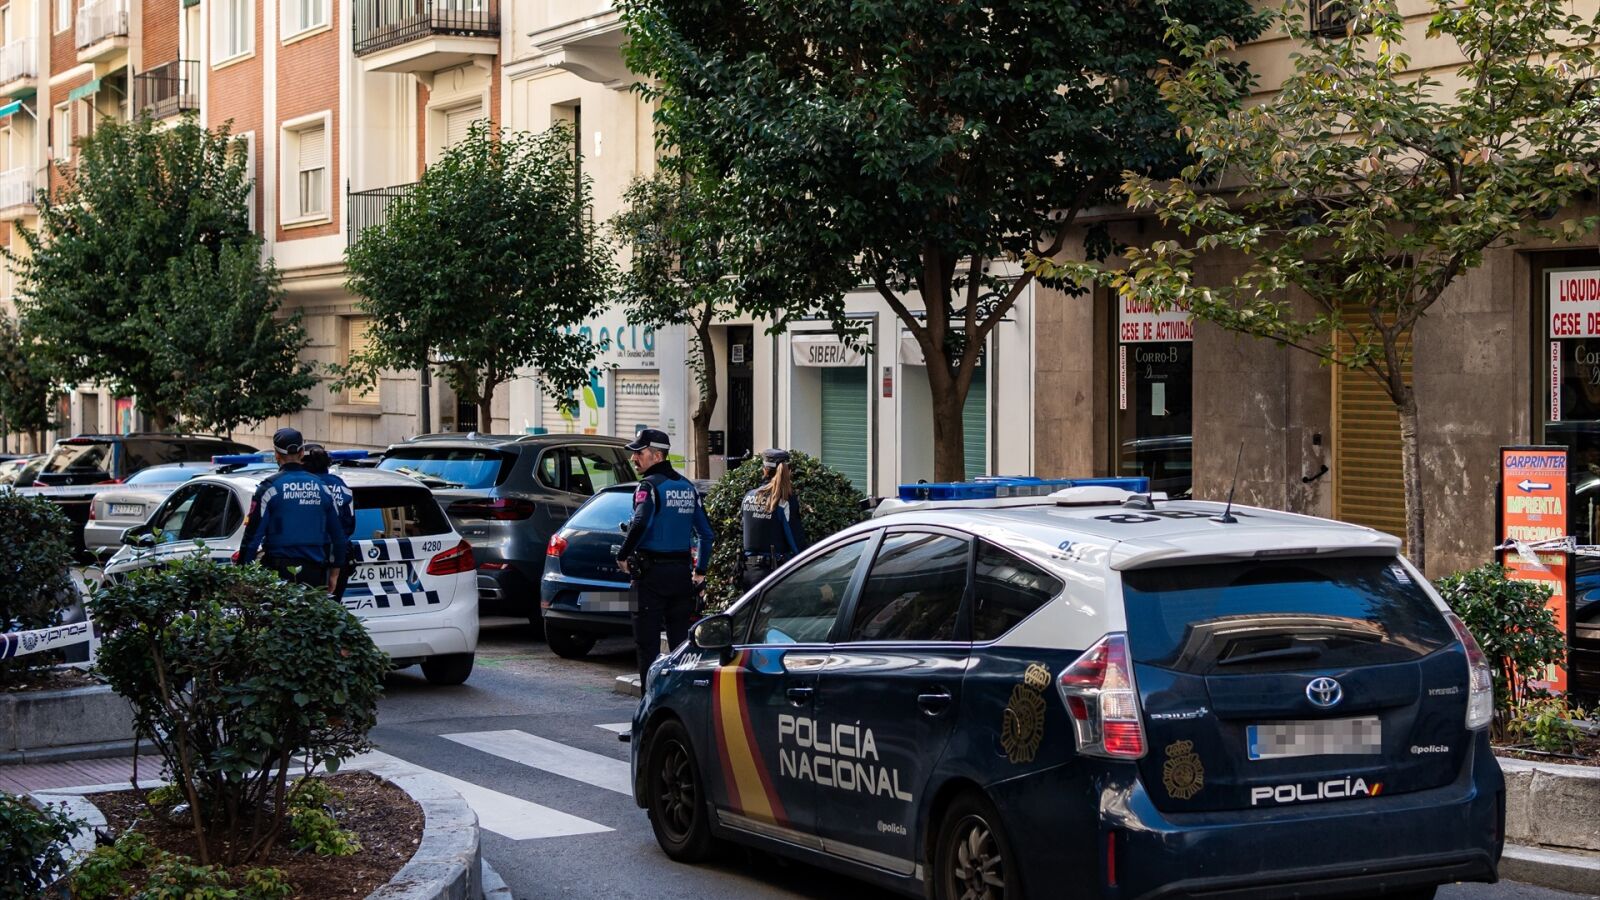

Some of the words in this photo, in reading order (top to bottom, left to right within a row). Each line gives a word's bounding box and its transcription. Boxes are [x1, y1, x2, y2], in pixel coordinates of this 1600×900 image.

[1121, 322, 1139, 340] CESE
[1143, 322, 1152, 340] DE
[1553, 313, 1581, 336] CESE
[808, 344, 846, 364] SIBERIA
[1505, 456, 1566, 469] CARPRINTER
[283, 480, 320, 491] POLICÍA
[666, 487, 695, 499] POLICÍA
[283, 491, 321, 500] MUNICIPAL
[666, 499, 695, 508] MUNICIPAL
[1506, 496, 1562, 515] IMPRENTA
[752, 512, 772, 520] Madrid
[422, 541, 442, 552] 4280
[351, 567, 375, 581] 246
[379, 566, 404, 580] MDH
[40, 623, 87, 644] POLICÍA
[778, 714, 879, 761] POLICÍA
[1410, 745, 1449, 755] @policia
[779, 748, 913, 802] NACIONAL
[1251, 776, 1370, 806] POLICÍA
[877, 820, 907, 836] @policia
